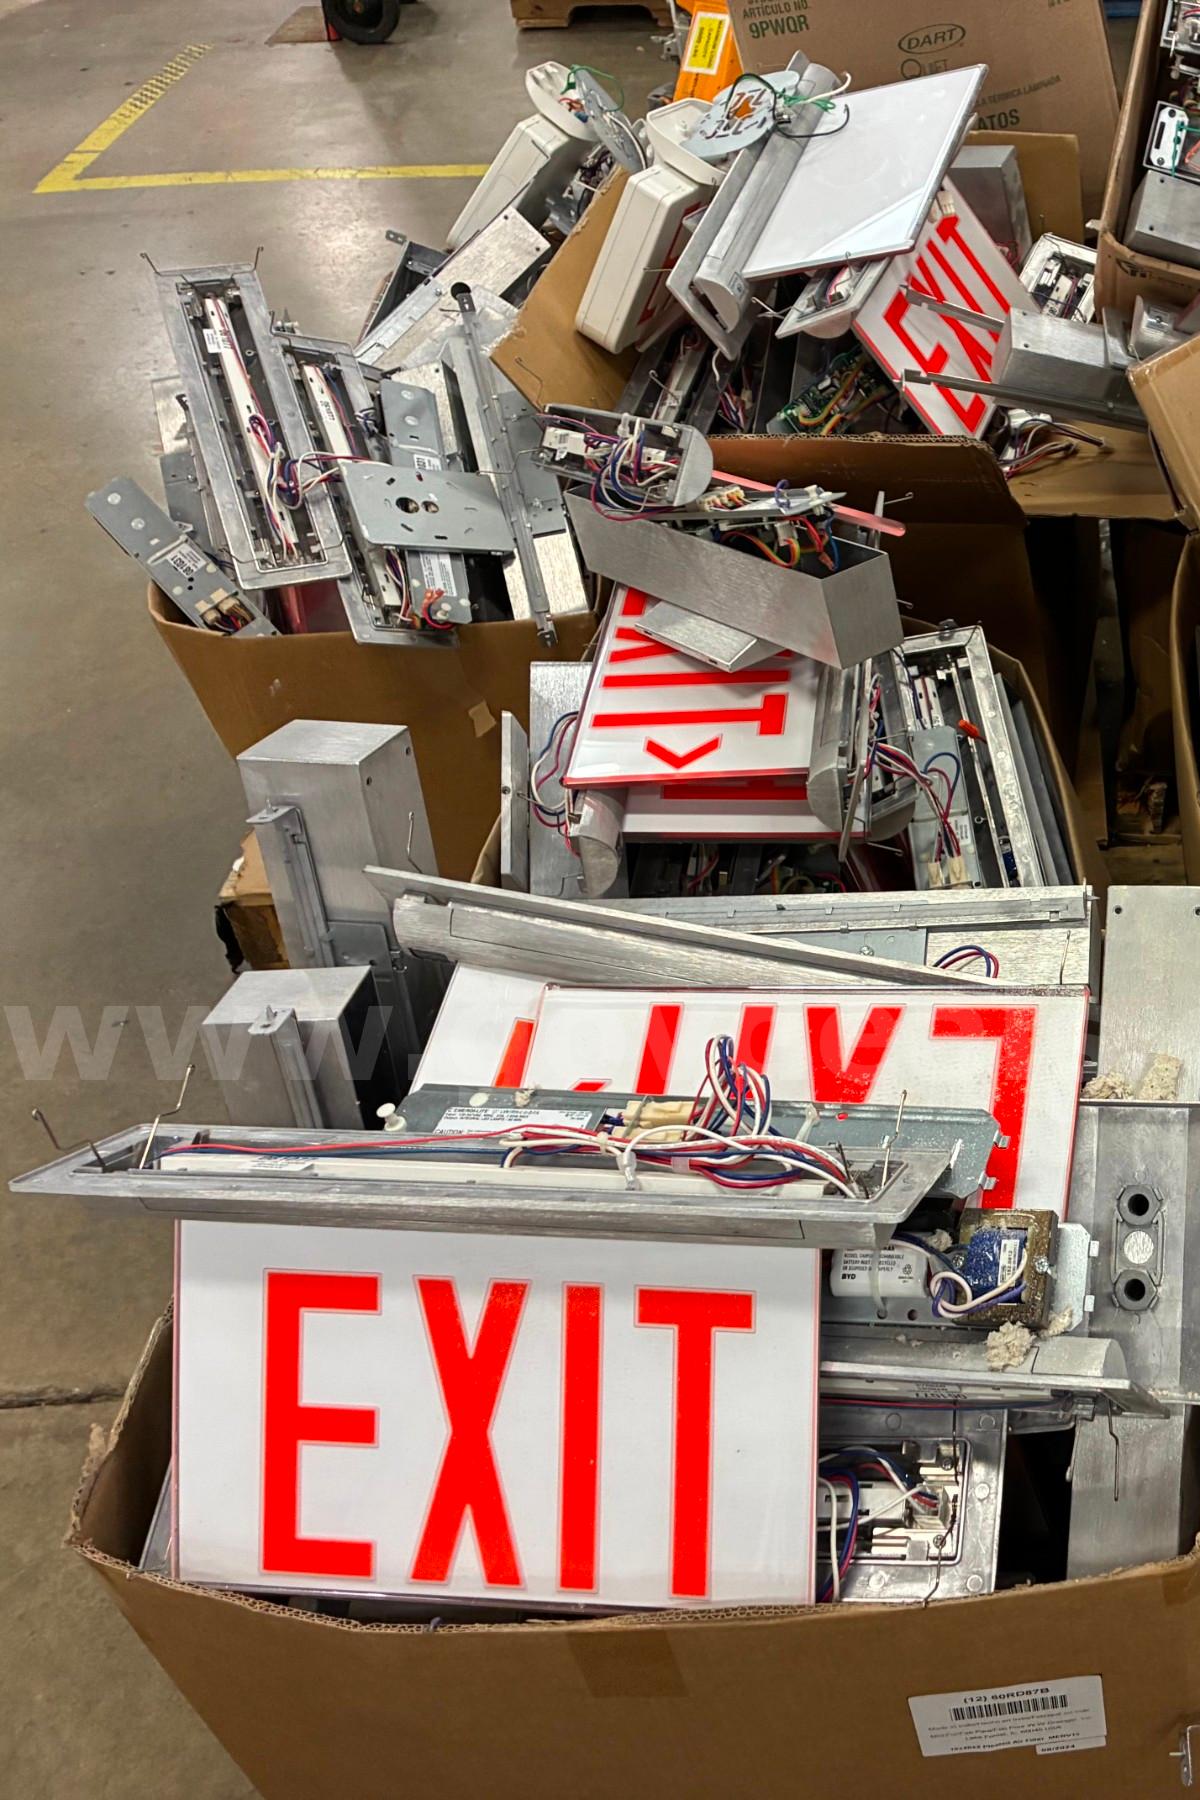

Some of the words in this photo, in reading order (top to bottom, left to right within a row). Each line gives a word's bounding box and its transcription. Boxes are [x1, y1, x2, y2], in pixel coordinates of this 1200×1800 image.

[749, 14, 810, 38] 9PWQR
[907, 28, 957, 49] DART
[592, 588, 797, 736] IT
[260, 1268, 757, 1599] EXIT
